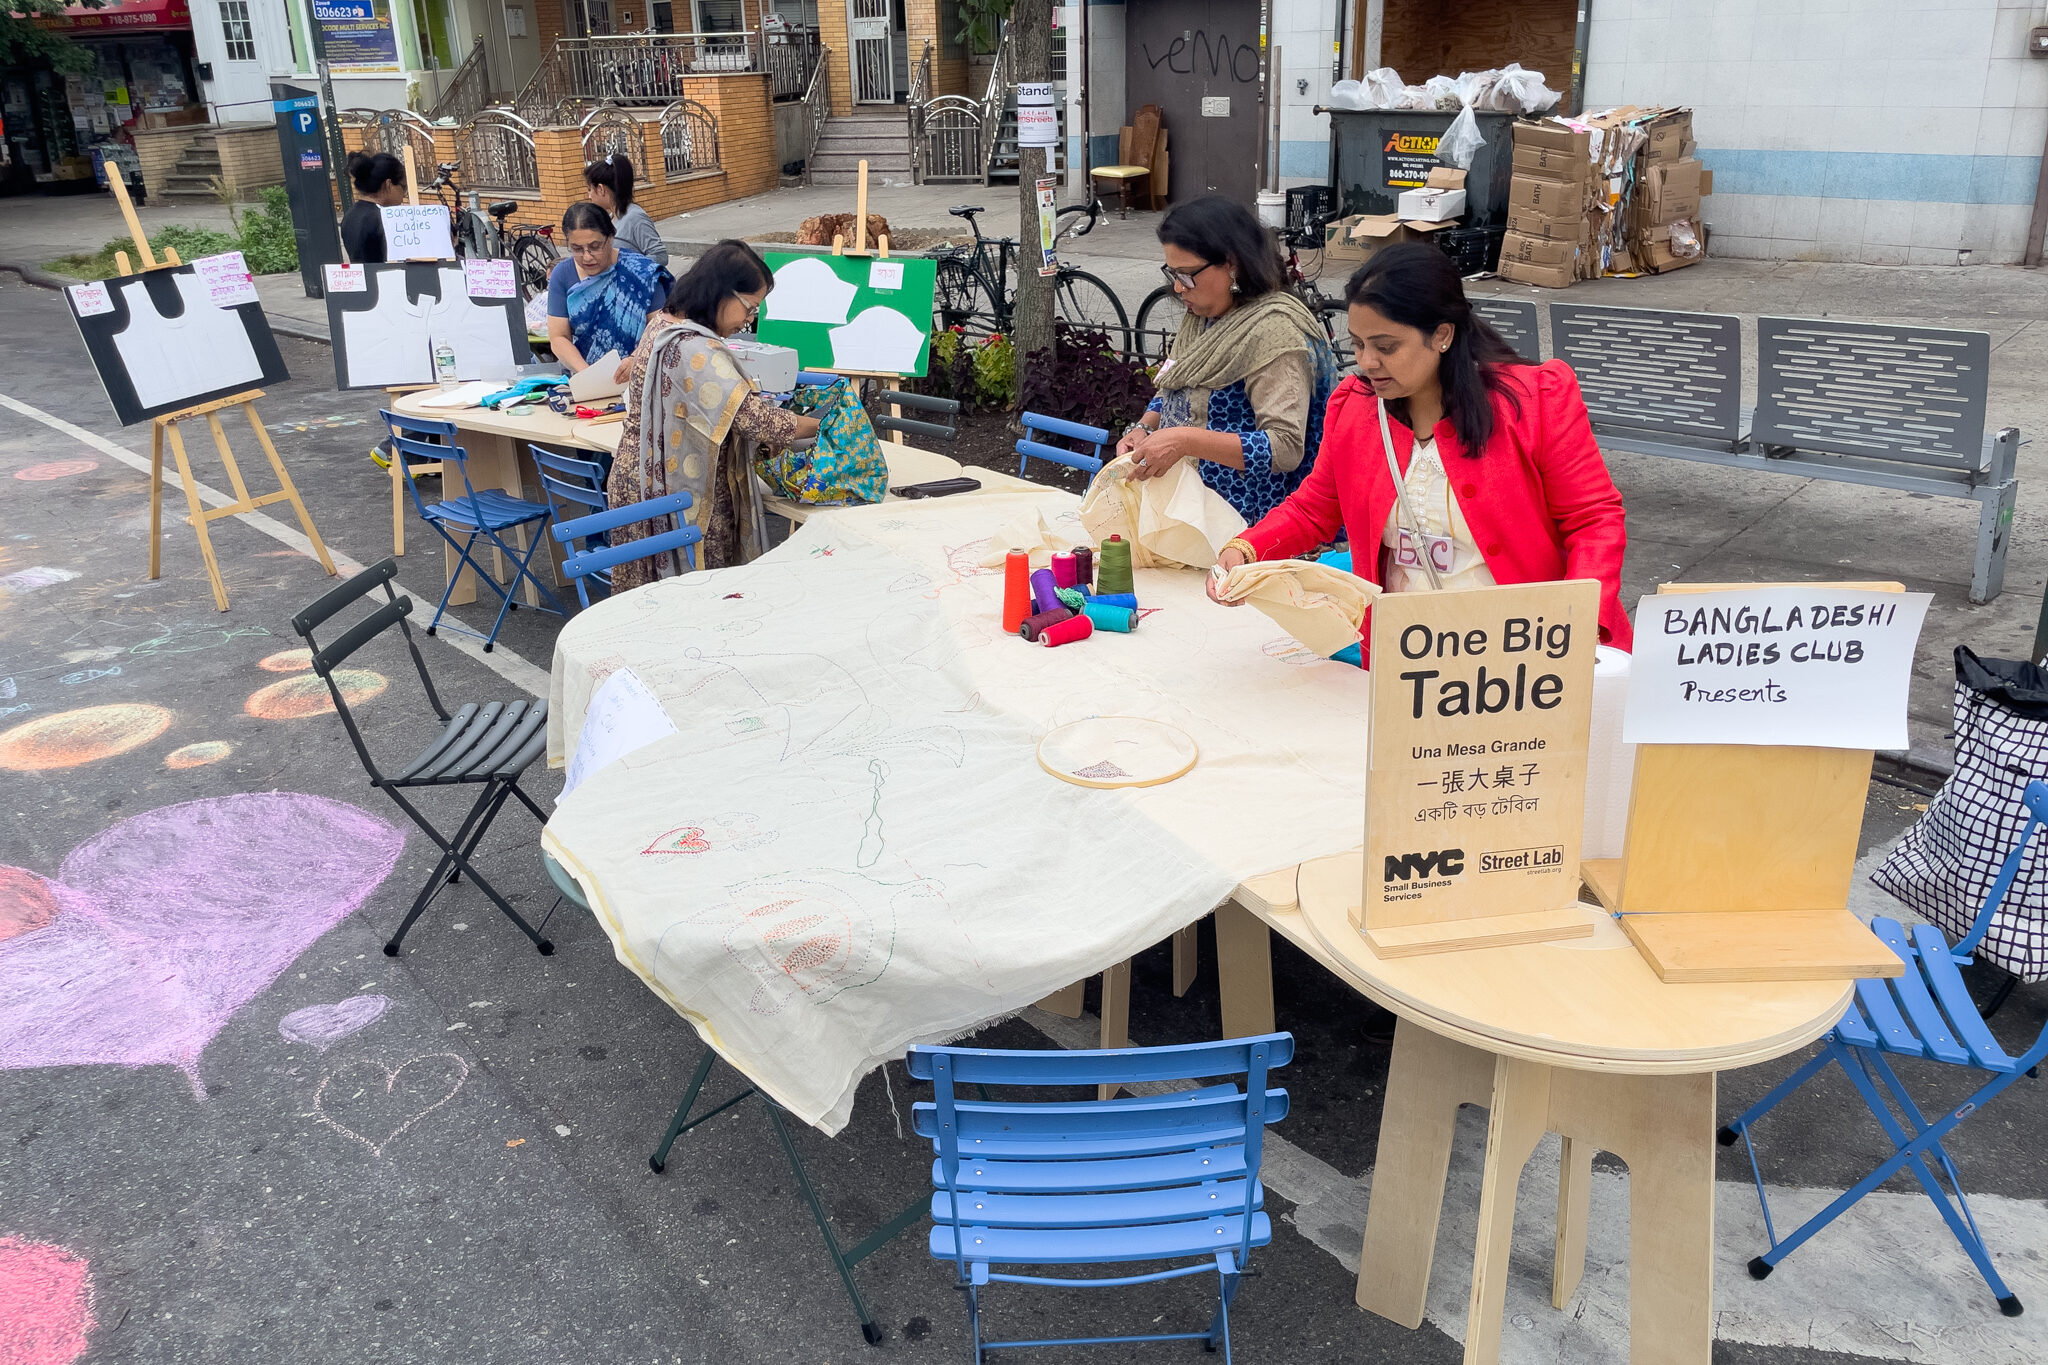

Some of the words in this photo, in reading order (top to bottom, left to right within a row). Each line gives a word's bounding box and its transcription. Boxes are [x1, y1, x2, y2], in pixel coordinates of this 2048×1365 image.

[316, 7, 351, 17] 306623
[299, 113, 312, 132] P
[1533, 183, 1542, 205] BATH
[386, 205, 448, 221] Bangladeshi
[395, 220, 431, 233] Ladies
[393, 232, 421, 247] Club
[1524, 240, 1534, 261] BATH
[1664, 604, 1896, 636] BANGLADESHI
[1400, 624, 1488, 660] One
[1502, 616, 1571, 659] Big
[1677, 641, 1781, 667] LADIES
[1790, 640, 1864, 664] CLUB
[1400, 663, 1564, 719] Table
[1680, 679, 1787, 703] Presents
[1412, 746, 1441, 759] Una
[1447, 743, 1486, 756] Mesa
[1491, 737, 1546, 753] Grande
[1417, 763, 1540, 794] 一張大桌子
[1414, 801, 1458, 822] একটি
[1462, 803, 1487, 819] বড়
[1492, 794, 1539, 815] টেবিল
[1384, 848, 1464, 882] NYC
[1481, 852, 1529, 871] Street
[1533, 849, 1561, 865] Lab
[1527, 867, 1562, 875] streetlab.org
[1384, 883, 1409, 892] Small
[1412, 880, 1452, 890] Business
[1384, 893, 1422, 902] Services
